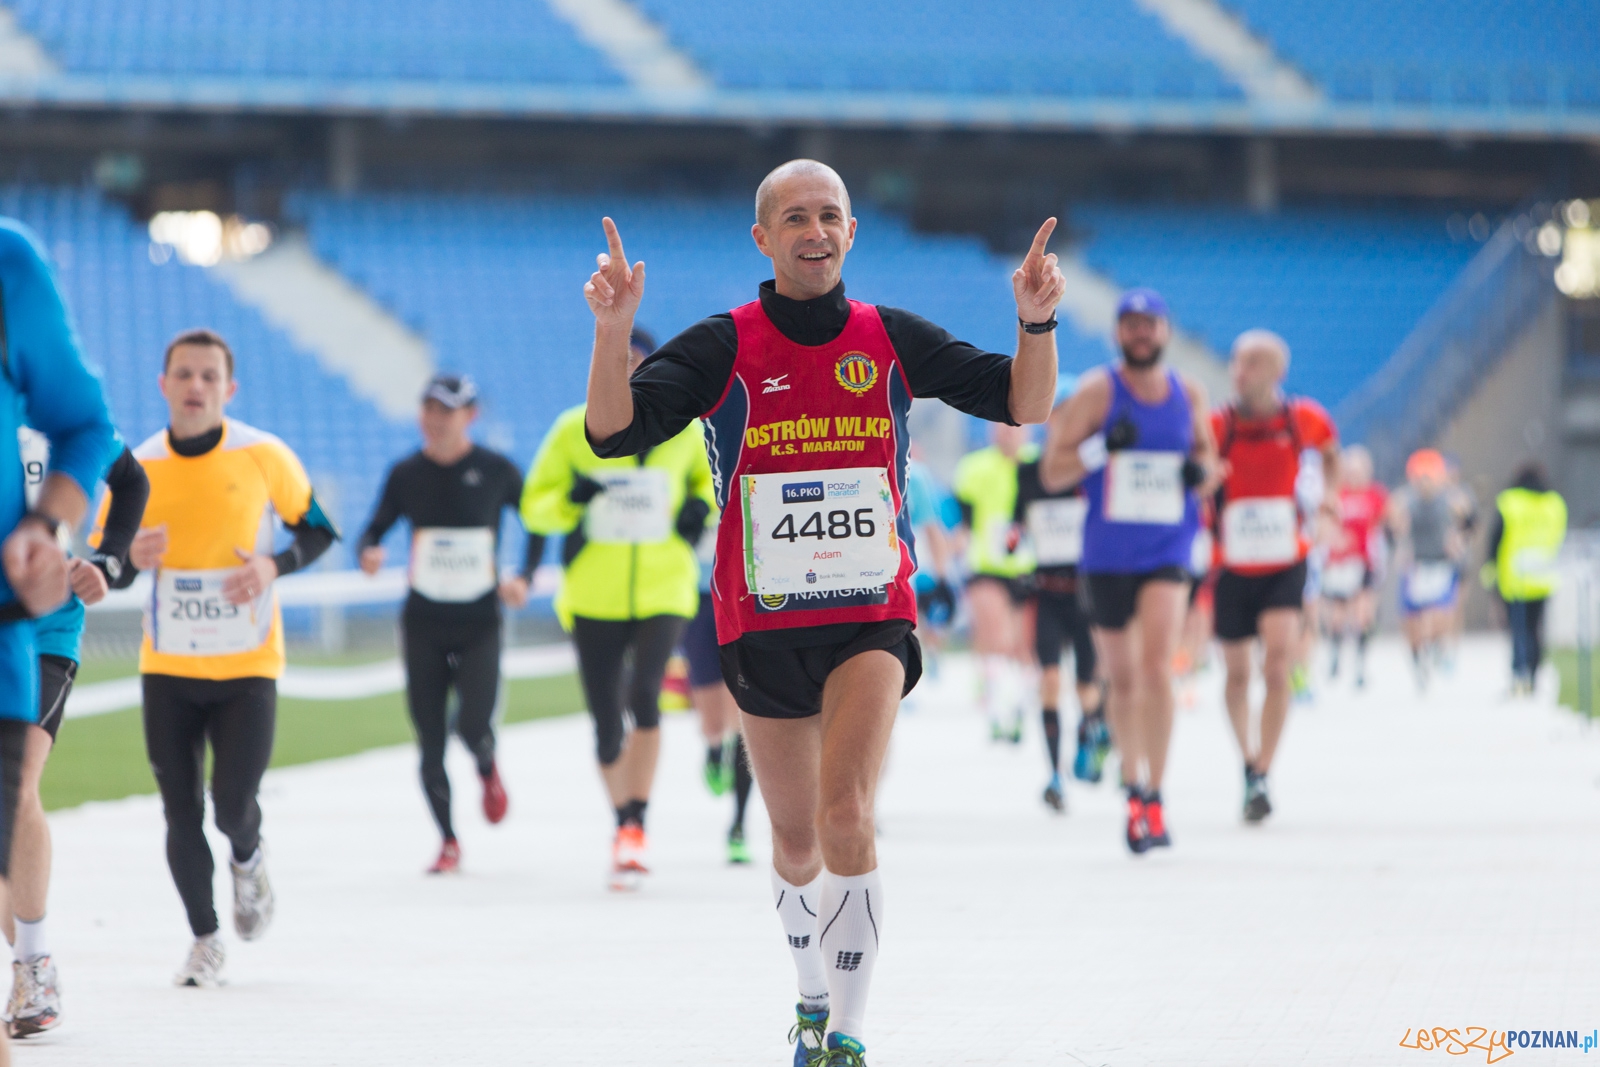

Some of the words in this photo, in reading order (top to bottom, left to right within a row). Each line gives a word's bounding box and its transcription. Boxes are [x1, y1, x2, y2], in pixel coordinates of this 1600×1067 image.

[746, 414, 830, 448] OSTRÓW
[771, 443, 798, 456] K.S.
[802, 440, 865, 453] MARATON
[785, 489, 799, 498] 16.
[800, 487, 821, 497] PKO
[828, 489, 860, 497] maraton
[771, 508, 875, 543] 4486
[813, 551, 842, 560] Adam
[835, 963, 858, 972] cep
